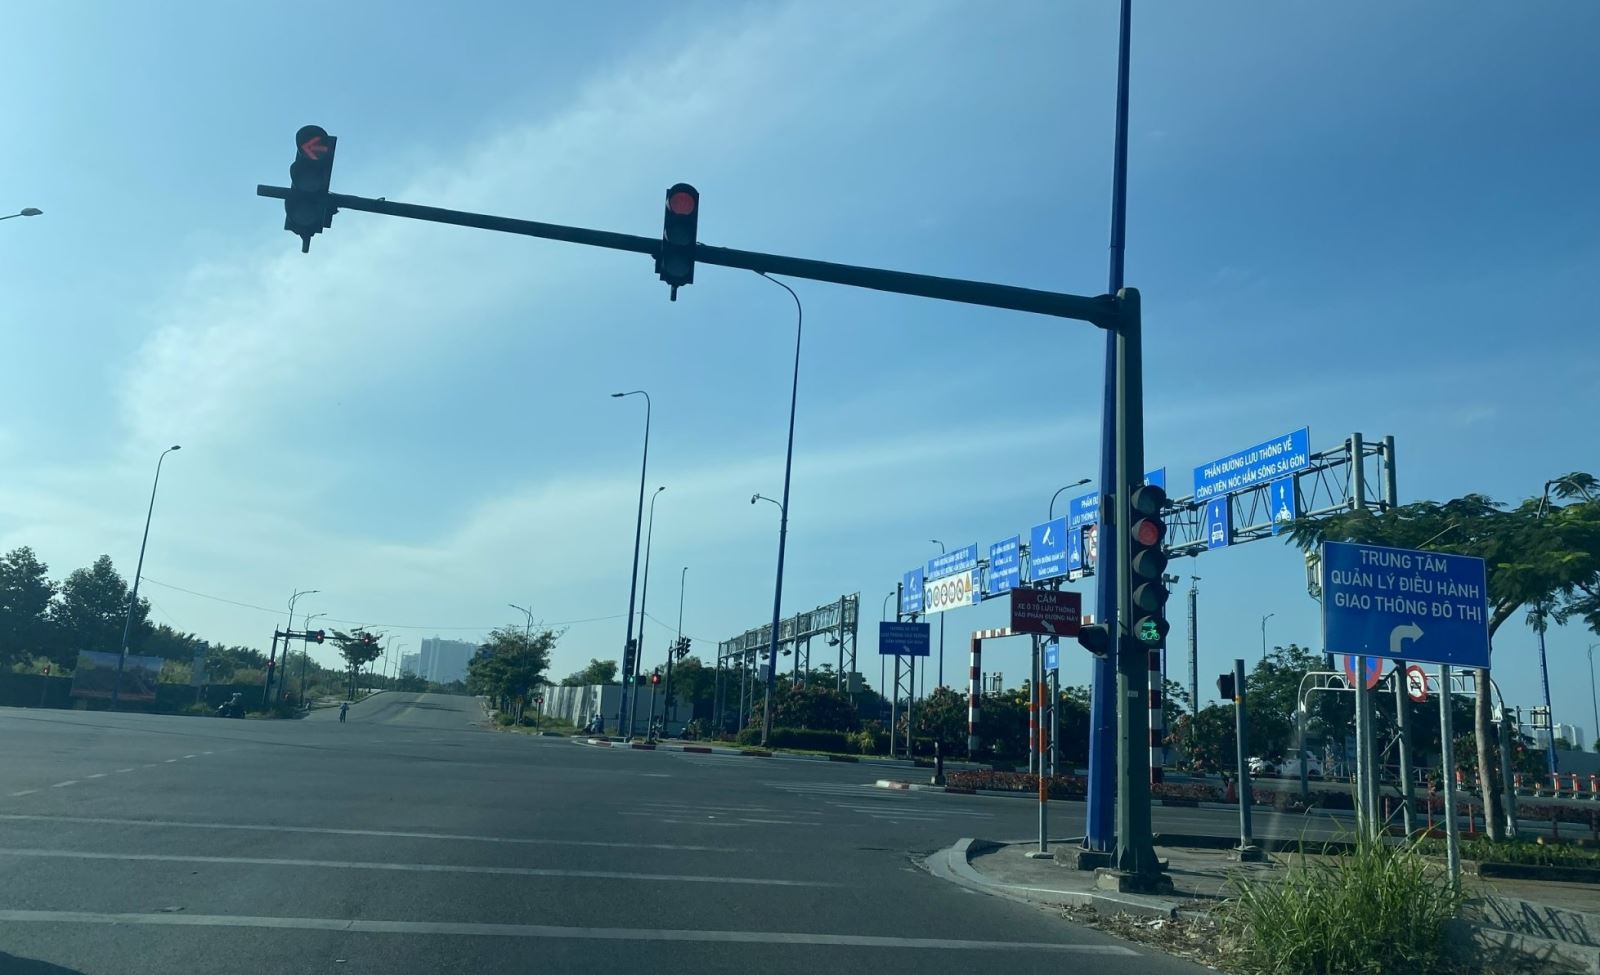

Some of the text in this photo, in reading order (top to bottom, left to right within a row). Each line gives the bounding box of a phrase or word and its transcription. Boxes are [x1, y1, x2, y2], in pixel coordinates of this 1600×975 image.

[1244, 451, 1258, 465] LƯU
[1259, 443, 1281, 460] THÔNG
[1197, 485, 1213, 498] CÔNG
[1213, 480, 1227, 493] VIÊN
[1257, 464, 1276, 479] SÔNG
[1277, 456, 1289, 472] SÀI
[1289, 453, 1305, 468] GÒN
[1359, 549, 1447, 573] TRUNG TÂM
[1331, 567, 1479, 599] QUẢN LÝ ĐIỀU HÀNH
[1335, 592, 1482, 625] GIAO THÔNG ĐÔ THỊ
